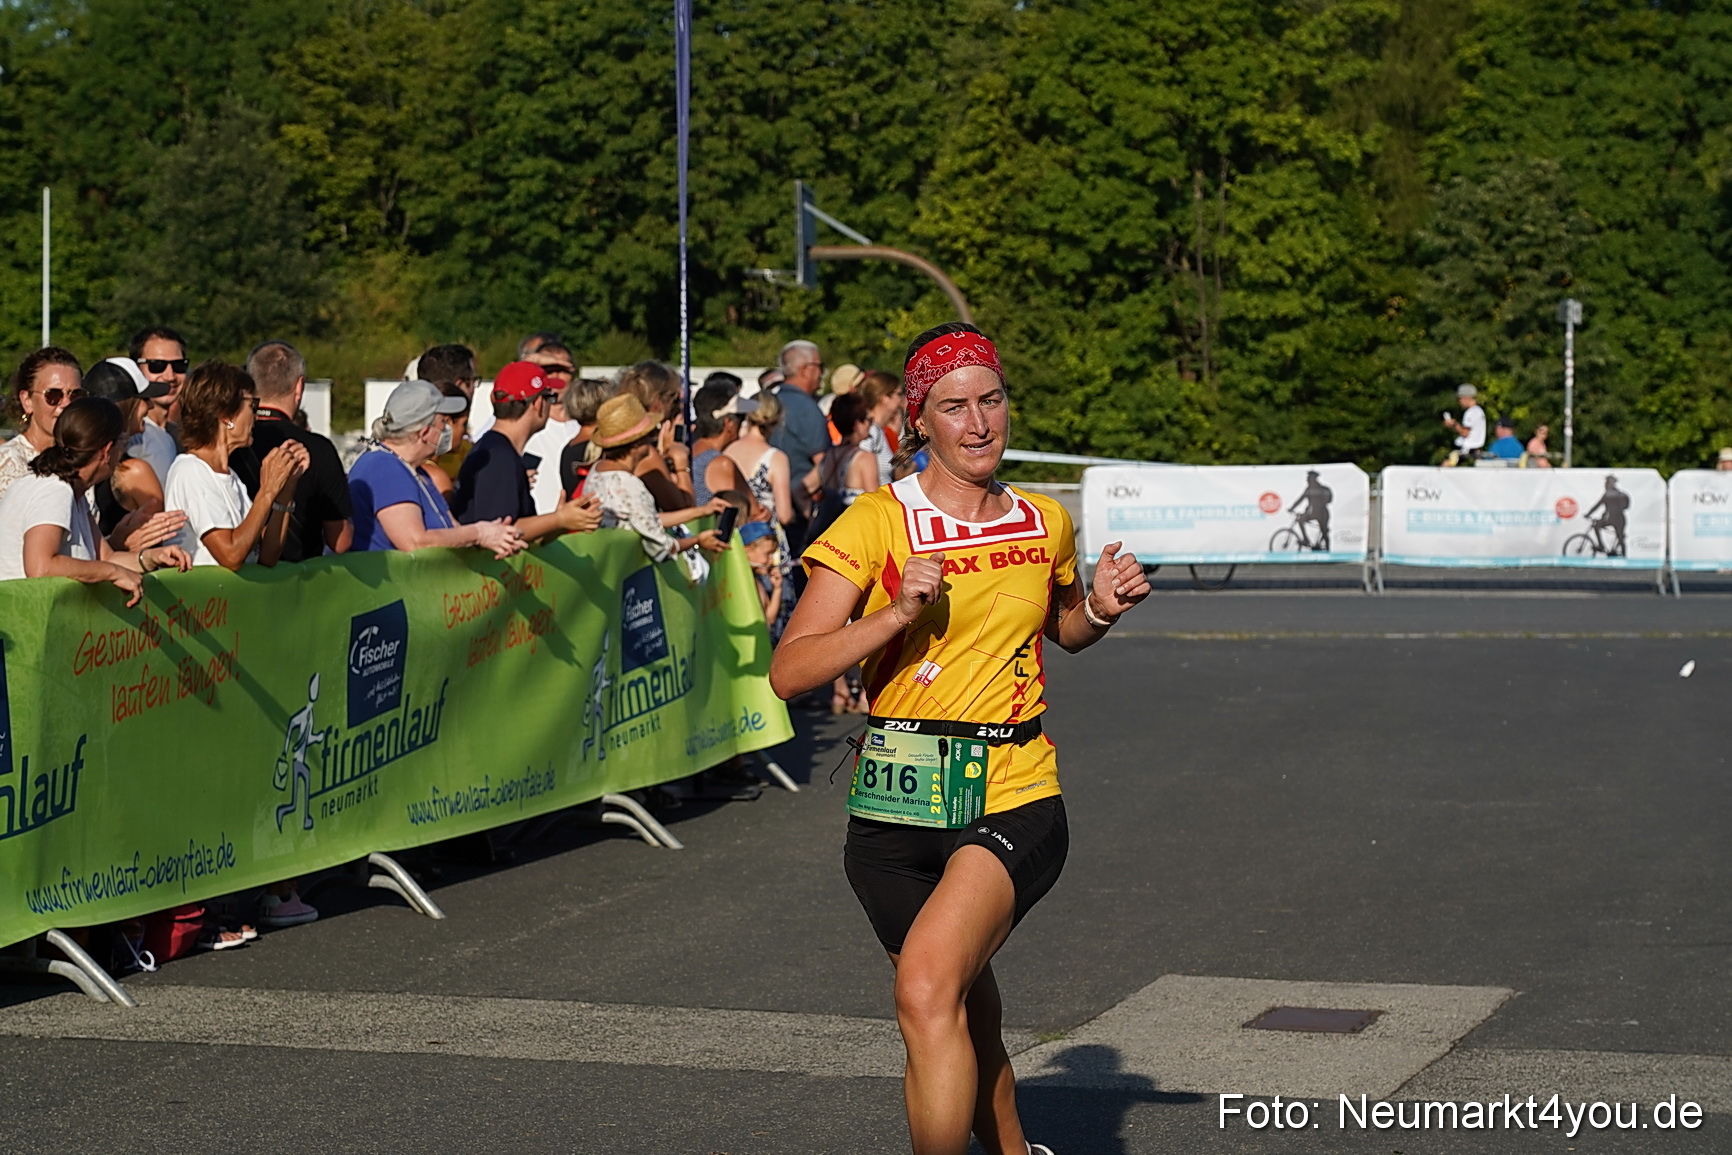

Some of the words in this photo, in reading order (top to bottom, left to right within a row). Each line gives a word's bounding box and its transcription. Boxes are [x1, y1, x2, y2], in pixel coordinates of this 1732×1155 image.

[942, 555, 982, 577] AX
[989, 545, 1051, 570] BÖGL
[73, 604, 161, 677] Gesunde
[168, 594, 228, 642] Firmen
[358, 639, 400, 667] Fischer
[112, 663, 170, 724] laufen
[176, 631, 241, 702] länger!
[320, 677, 449, 791] firmenlauf
[609, 714, 661, 750] neumarkt
[884, 720, 921, 732] 2XU
[976, 726, 1014, 738] 2XU
[863, 759, 918, 794] 816
[930, 773, 942, 815] 2022
[321, 775, 379, 820] neumarkt
[902, 796, 931, 807] Marina
[991, 831, 1014, 851] JAKO
